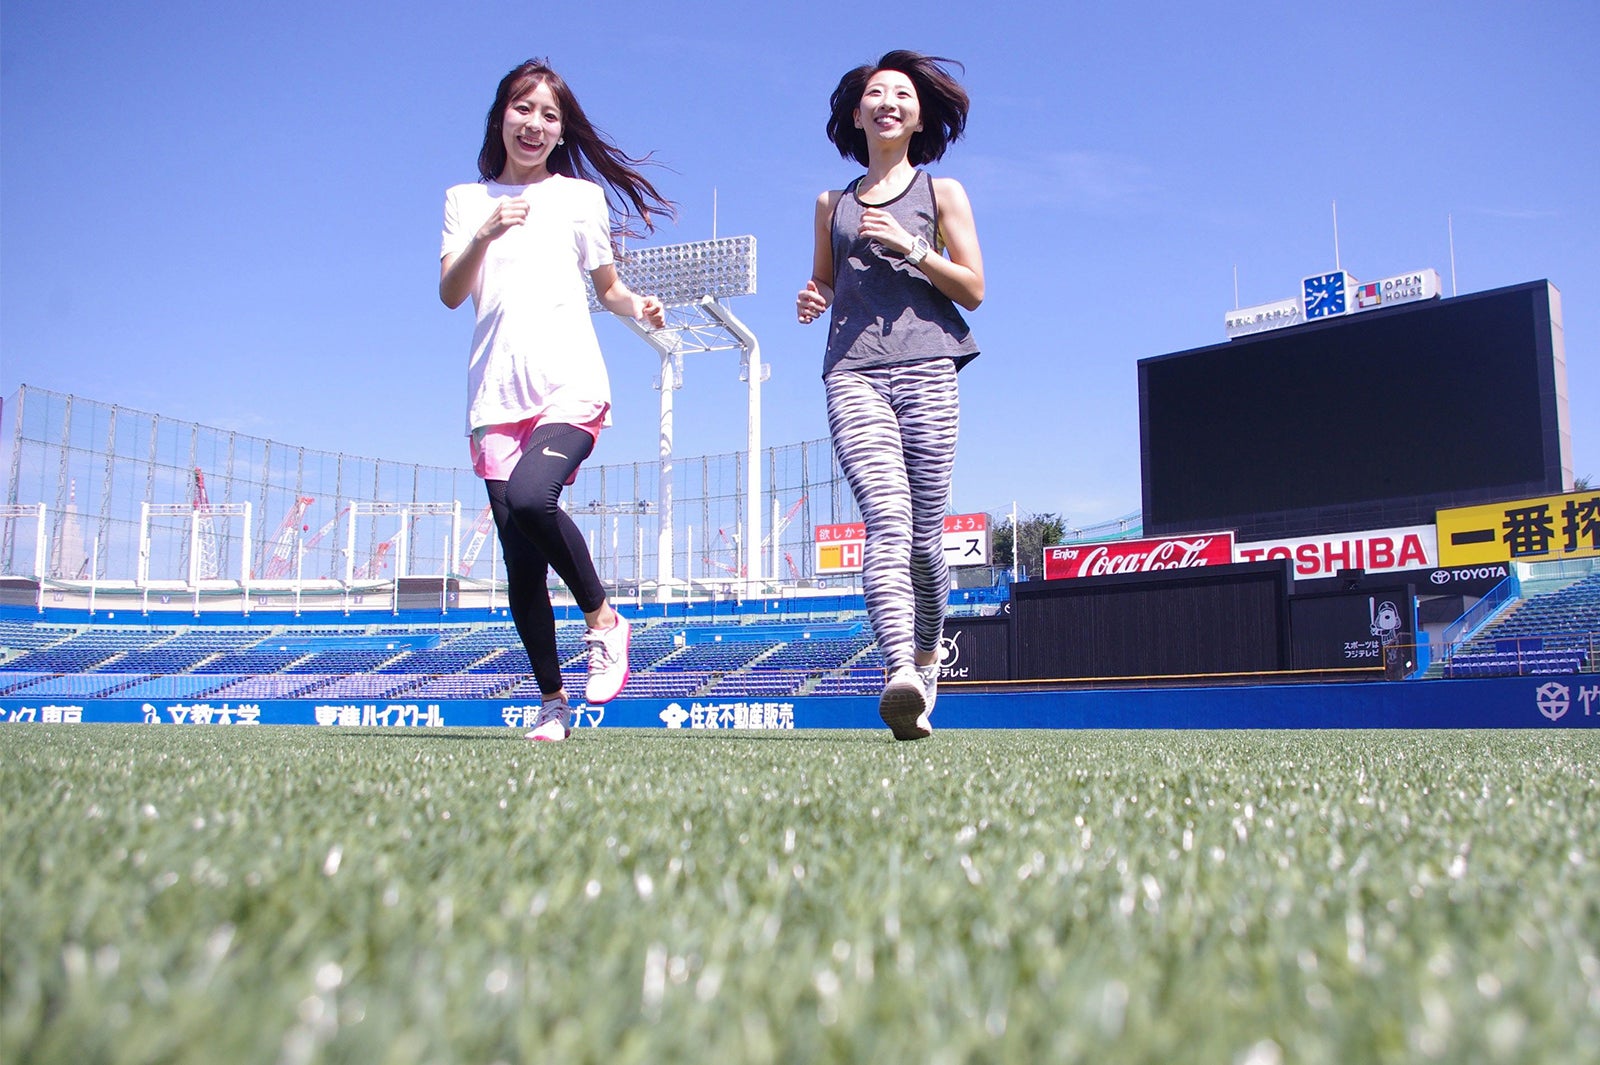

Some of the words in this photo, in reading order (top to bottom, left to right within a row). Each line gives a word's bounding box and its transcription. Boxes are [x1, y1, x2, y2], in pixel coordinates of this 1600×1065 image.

[1385, 275, 1421, 290] OPEN
[1386, 287, 1422, 301] HOUSE
[1052, 548, 1079, 560] Enjoy
[1452, 566, 1507, 581] TOYOTA
[1344, 640, 1380, 650] スポーツは
[1344, 649, 1379, 659] フジテレビ
[938, 667, 969, 677] テレビ
[167, 703, 260, 724] 文教大学
[315, 705, 444, 726] 東進ハイスクール
[690, 702, 794, 729] 住友不動産販売
